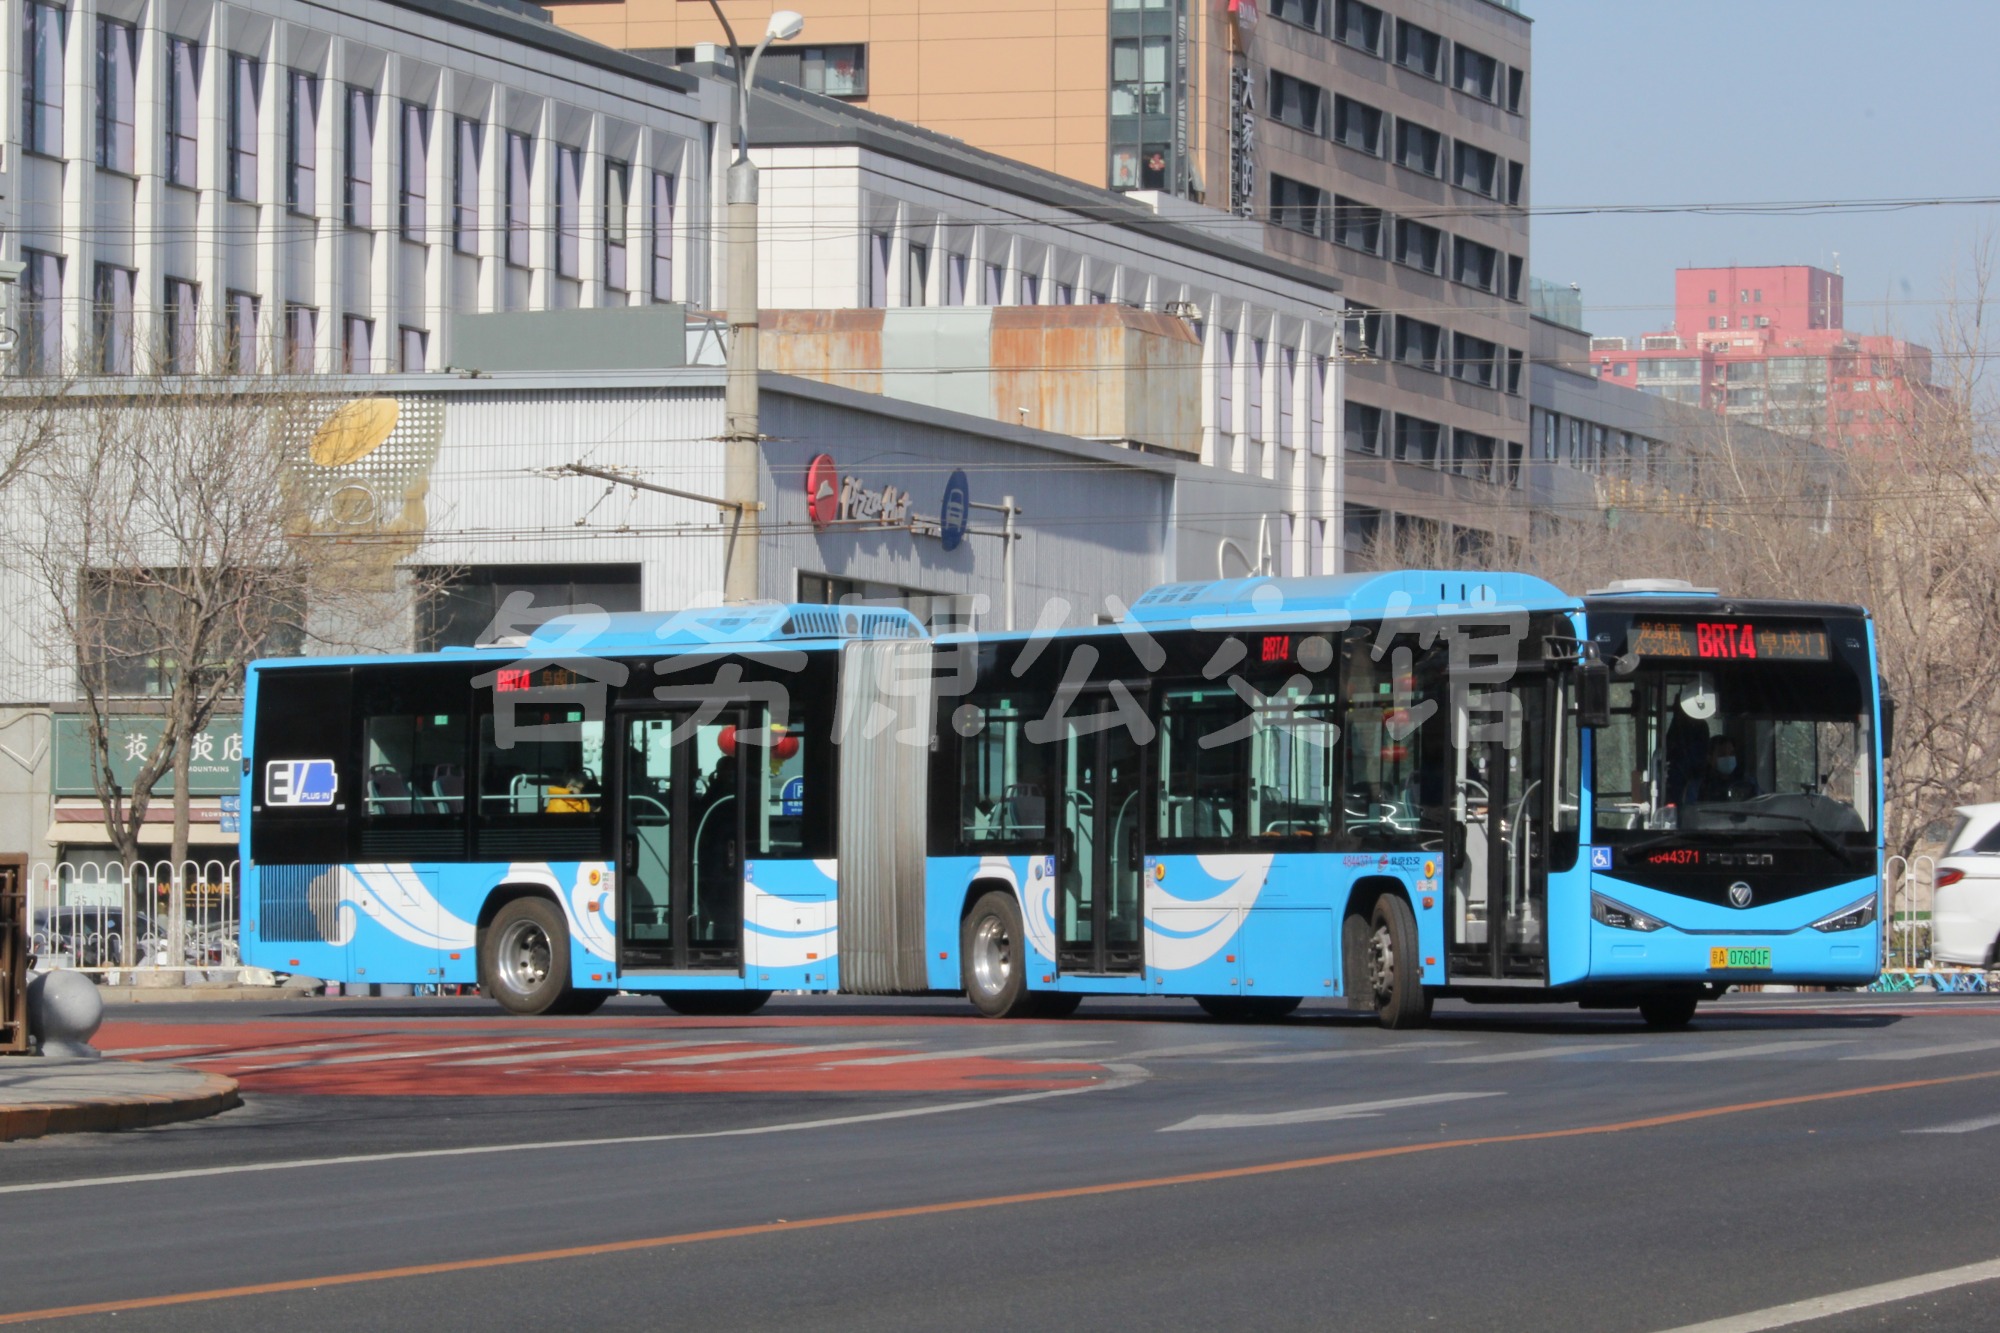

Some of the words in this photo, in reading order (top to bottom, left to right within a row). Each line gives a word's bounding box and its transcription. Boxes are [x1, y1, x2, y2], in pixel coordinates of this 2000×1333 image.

[840, 475, 882, 521] Pizza
[880, 485, 913, 527] Hut
[1262, 635, 1289, 661] BRT4
[1696, 623, 1757, 658] BRT4
[1760, 630, 1826, 657] 阜成门
[497, 669, 531, 692] BRT4
[125, 733, 242, 761] 花花店
[301, 792, 330, 800] PLUG-IN
[158, 882, 232, 895] WLCOME
